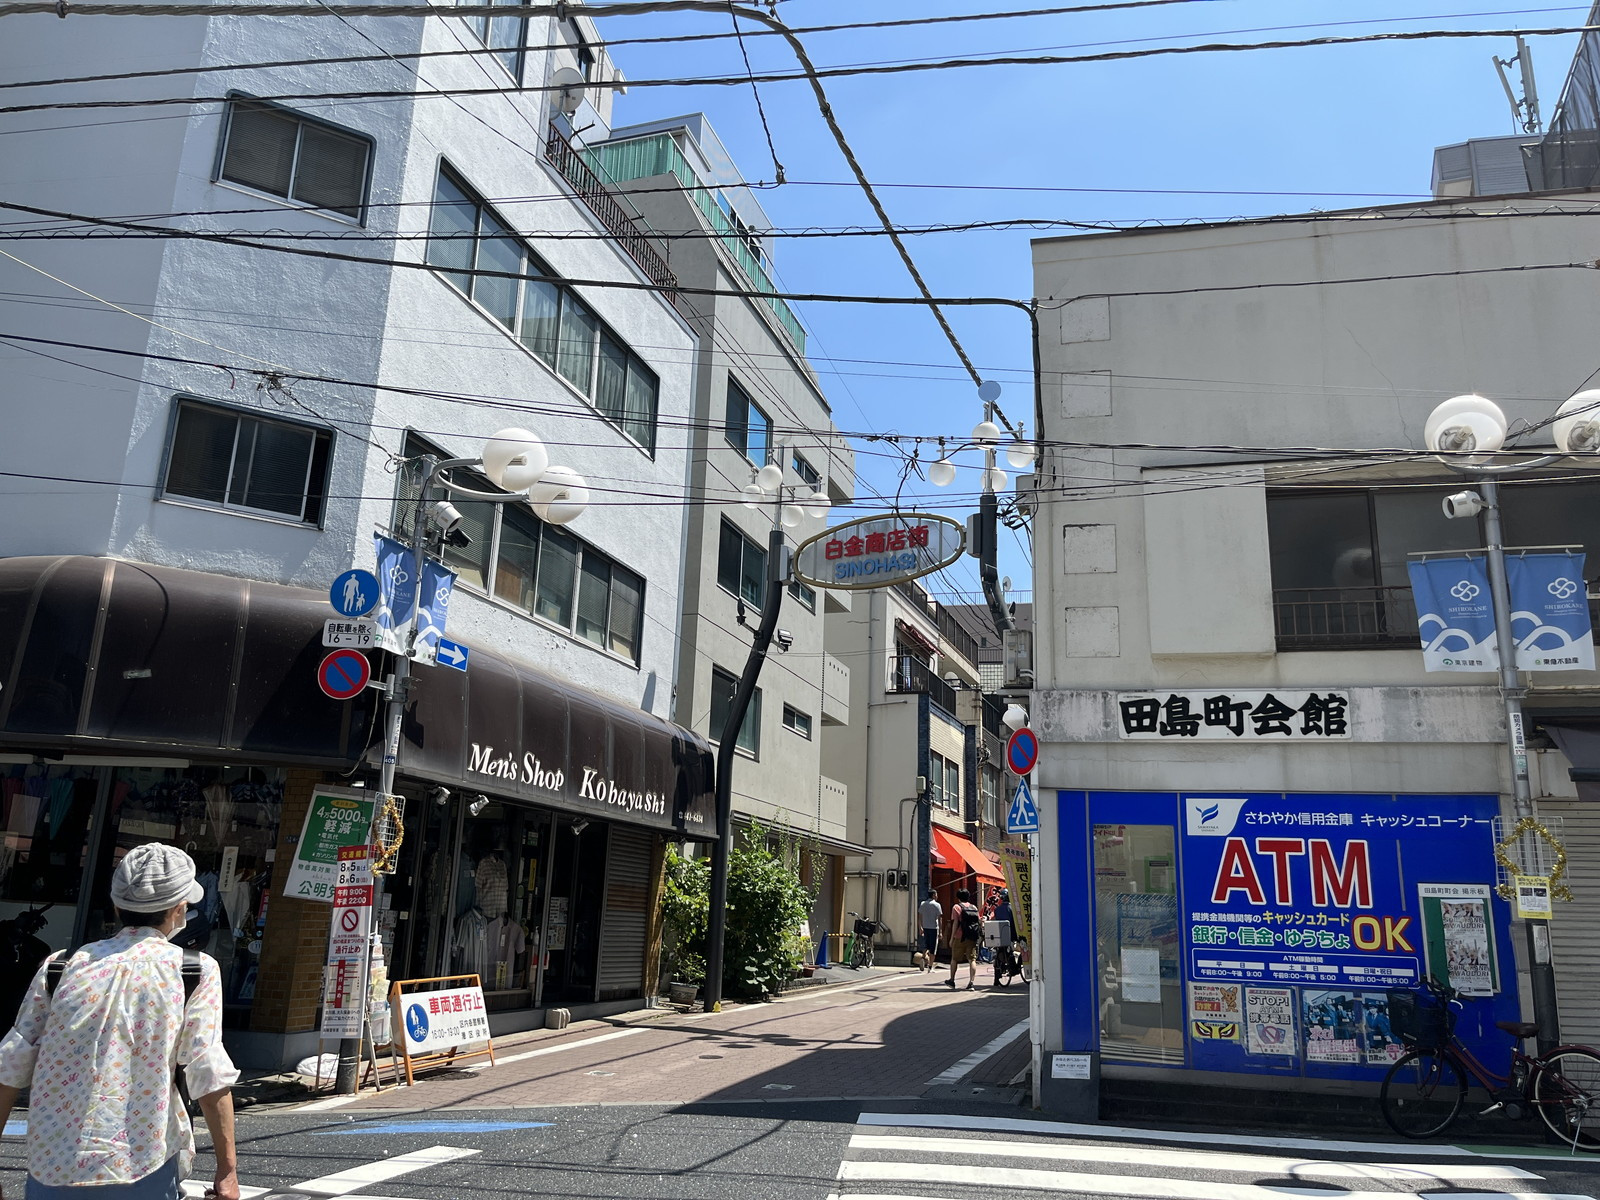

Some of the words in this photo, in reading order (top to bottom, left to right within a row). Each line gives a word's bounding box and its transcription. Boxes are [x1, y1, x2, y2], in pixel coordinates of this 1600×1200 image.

[825, 525, 929, 560] 白金商店街
[328, 623, 371, 634] 自転車を除く
[328, 633, 340, 644] 16
[357, 635, 369, 645] 19
[1543, 657, 1579, 666] 東急不動産
[1119, 693, 1348, 737] 田島町会館
[467, 743, 518, 780] Men's
[521, 751, 565, 792] Shop
[1245, 811, 1353, 826] さわやか信用金庫
[1360, 814, 1490, 828] キャッシュコーナー
[1211, 837, 1373, 908] ATM
[1192, 912, 1261, 923] 提携金融機関等の
[1263, 910, 1350, 926] キャッシュカード
[1191, 925, 1350, 949] 銀行・信金・ゆうちょ
[1353, 915, 1414, 952] OK
[428, 991, 483, 1015] 車両通行止
[1248, 995, 1289, 1006] STOP!
[1249, 1012, 1291, 1025] 携帯電話
